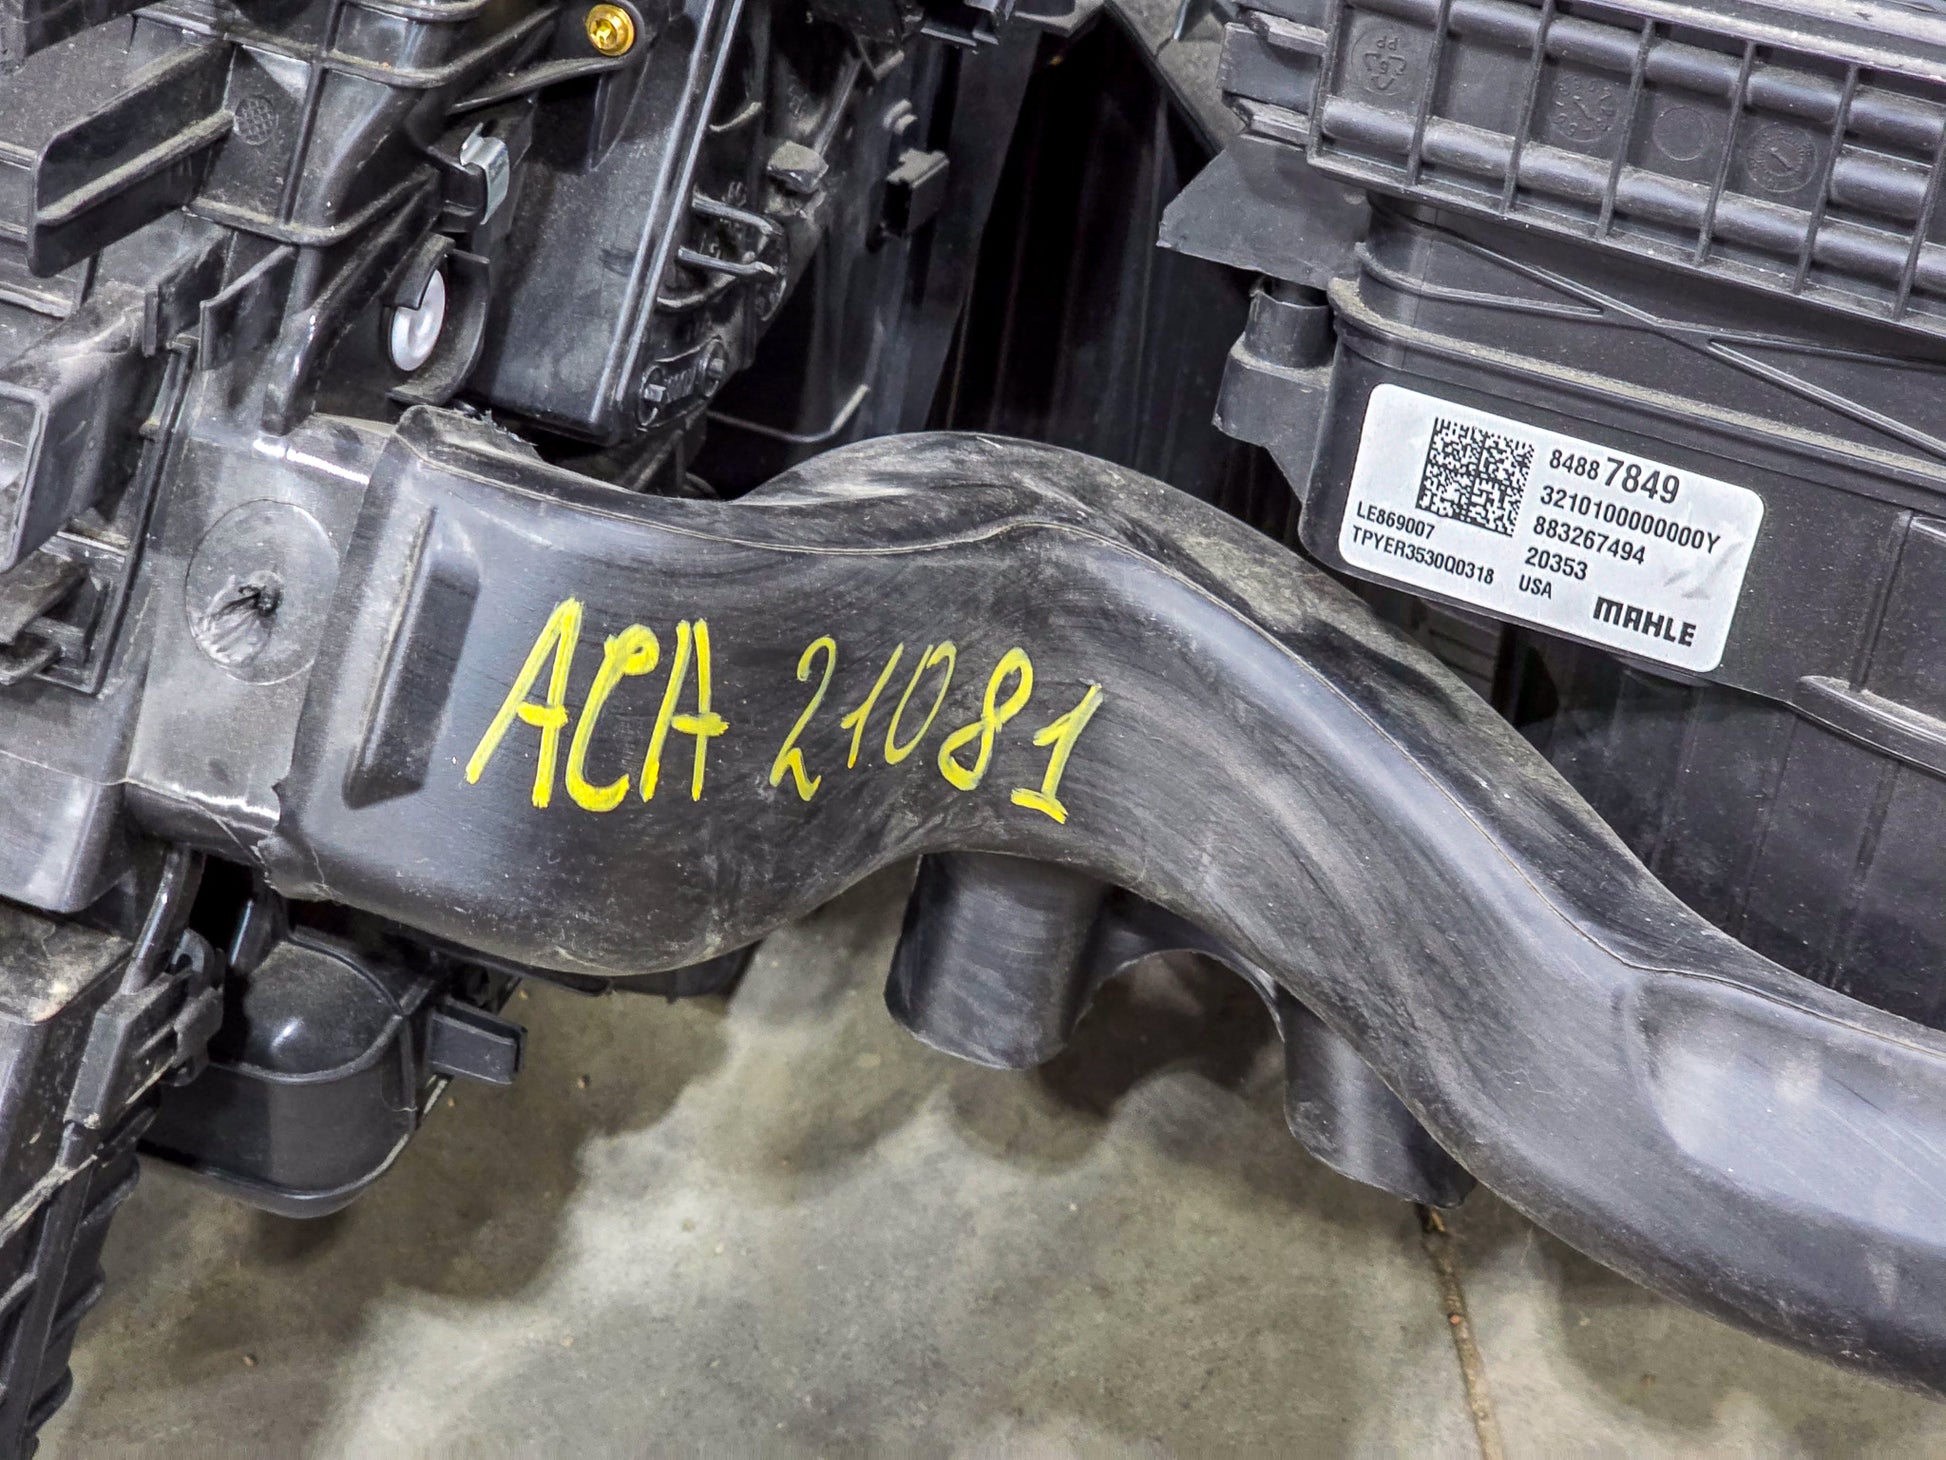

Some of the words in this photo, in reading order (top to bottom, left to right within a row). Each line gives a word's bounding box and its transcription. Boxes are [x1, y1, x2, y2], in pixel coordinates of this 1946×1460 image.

[1356, 500, 1436, 540] LE869007
[1533, 515, 1646, 565] 883267494
[1540, 485, 1721, 554] 3210100000000Y
[1353, 525, 1495, 585] TPYER3530Q0318
[1524, 546, 1588, 581] 20353
[1518, 574, 1552, 599] USA
[1592, 596, 1697, 647] MAHLE
[466, 598, 729, 812] ACA
[770, 635, 1103, 824] 21081
